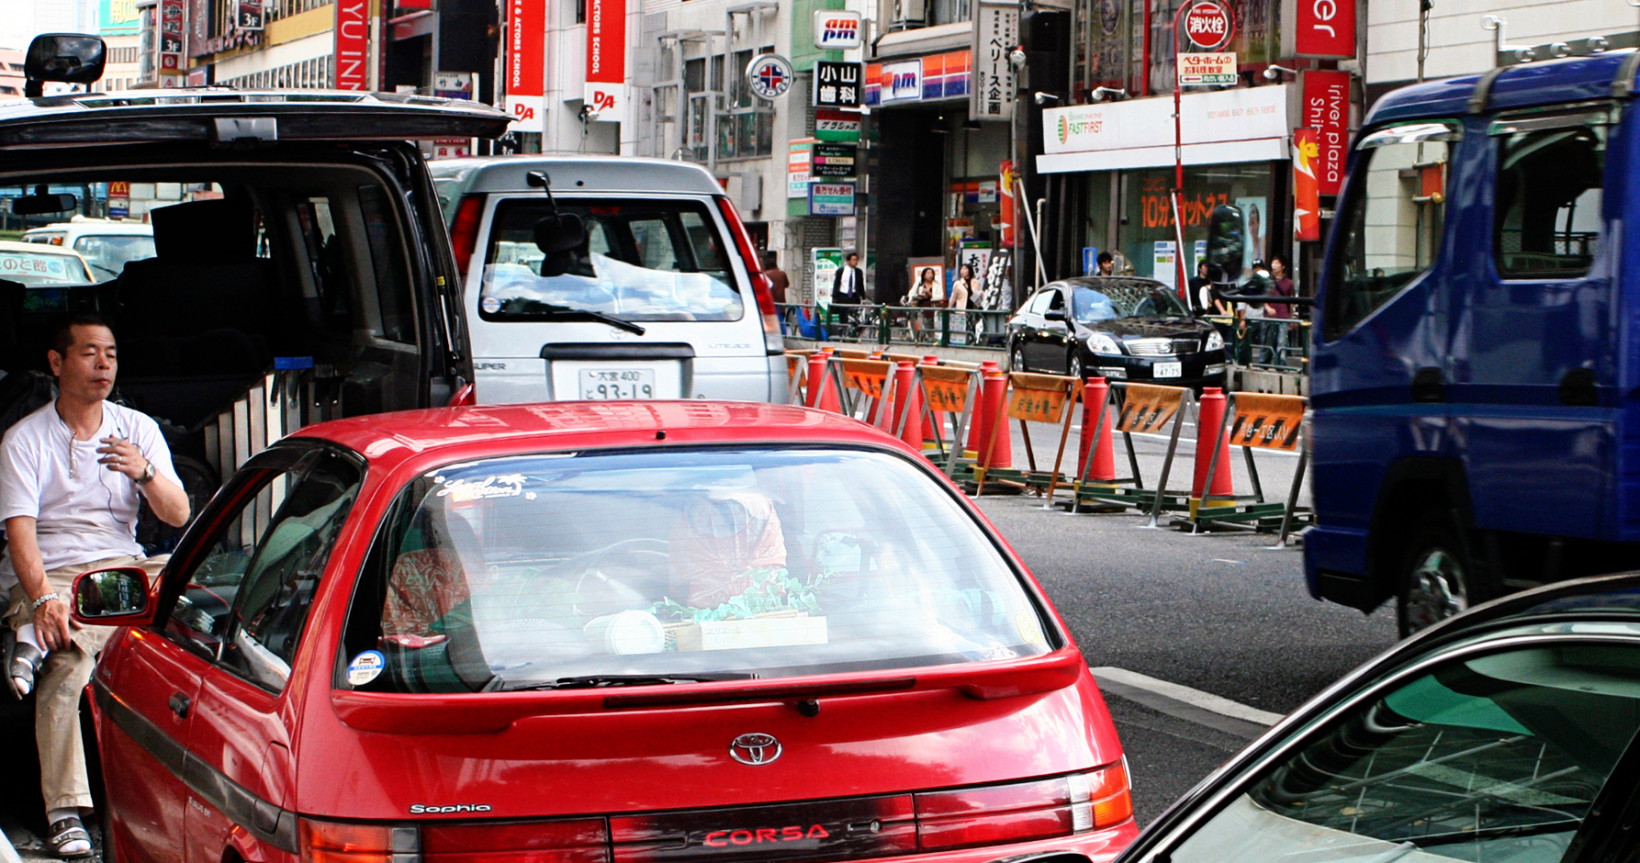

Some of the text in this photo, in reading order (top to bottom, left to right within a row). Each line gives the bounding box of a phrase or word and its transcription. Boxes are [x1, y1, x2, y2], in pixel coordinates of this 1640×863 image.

[243, 13, 258, 27] 3F
[342, 3, 363, 39] YU
[1190, 16, 1224, 33] 消火栓
[823, 30, 855, 42] pm
[166, 39, 181, 53] 3F
[592, 37, 600, 75] SCHOOL
[820, 65, 857, 83] 小山
[819, 85, 856, 104] 歯科
[1326, 131, 1341, 182] plaza
[409, 803, 491, 814] Sophia
[705, 824, 829, 847] CORSA
